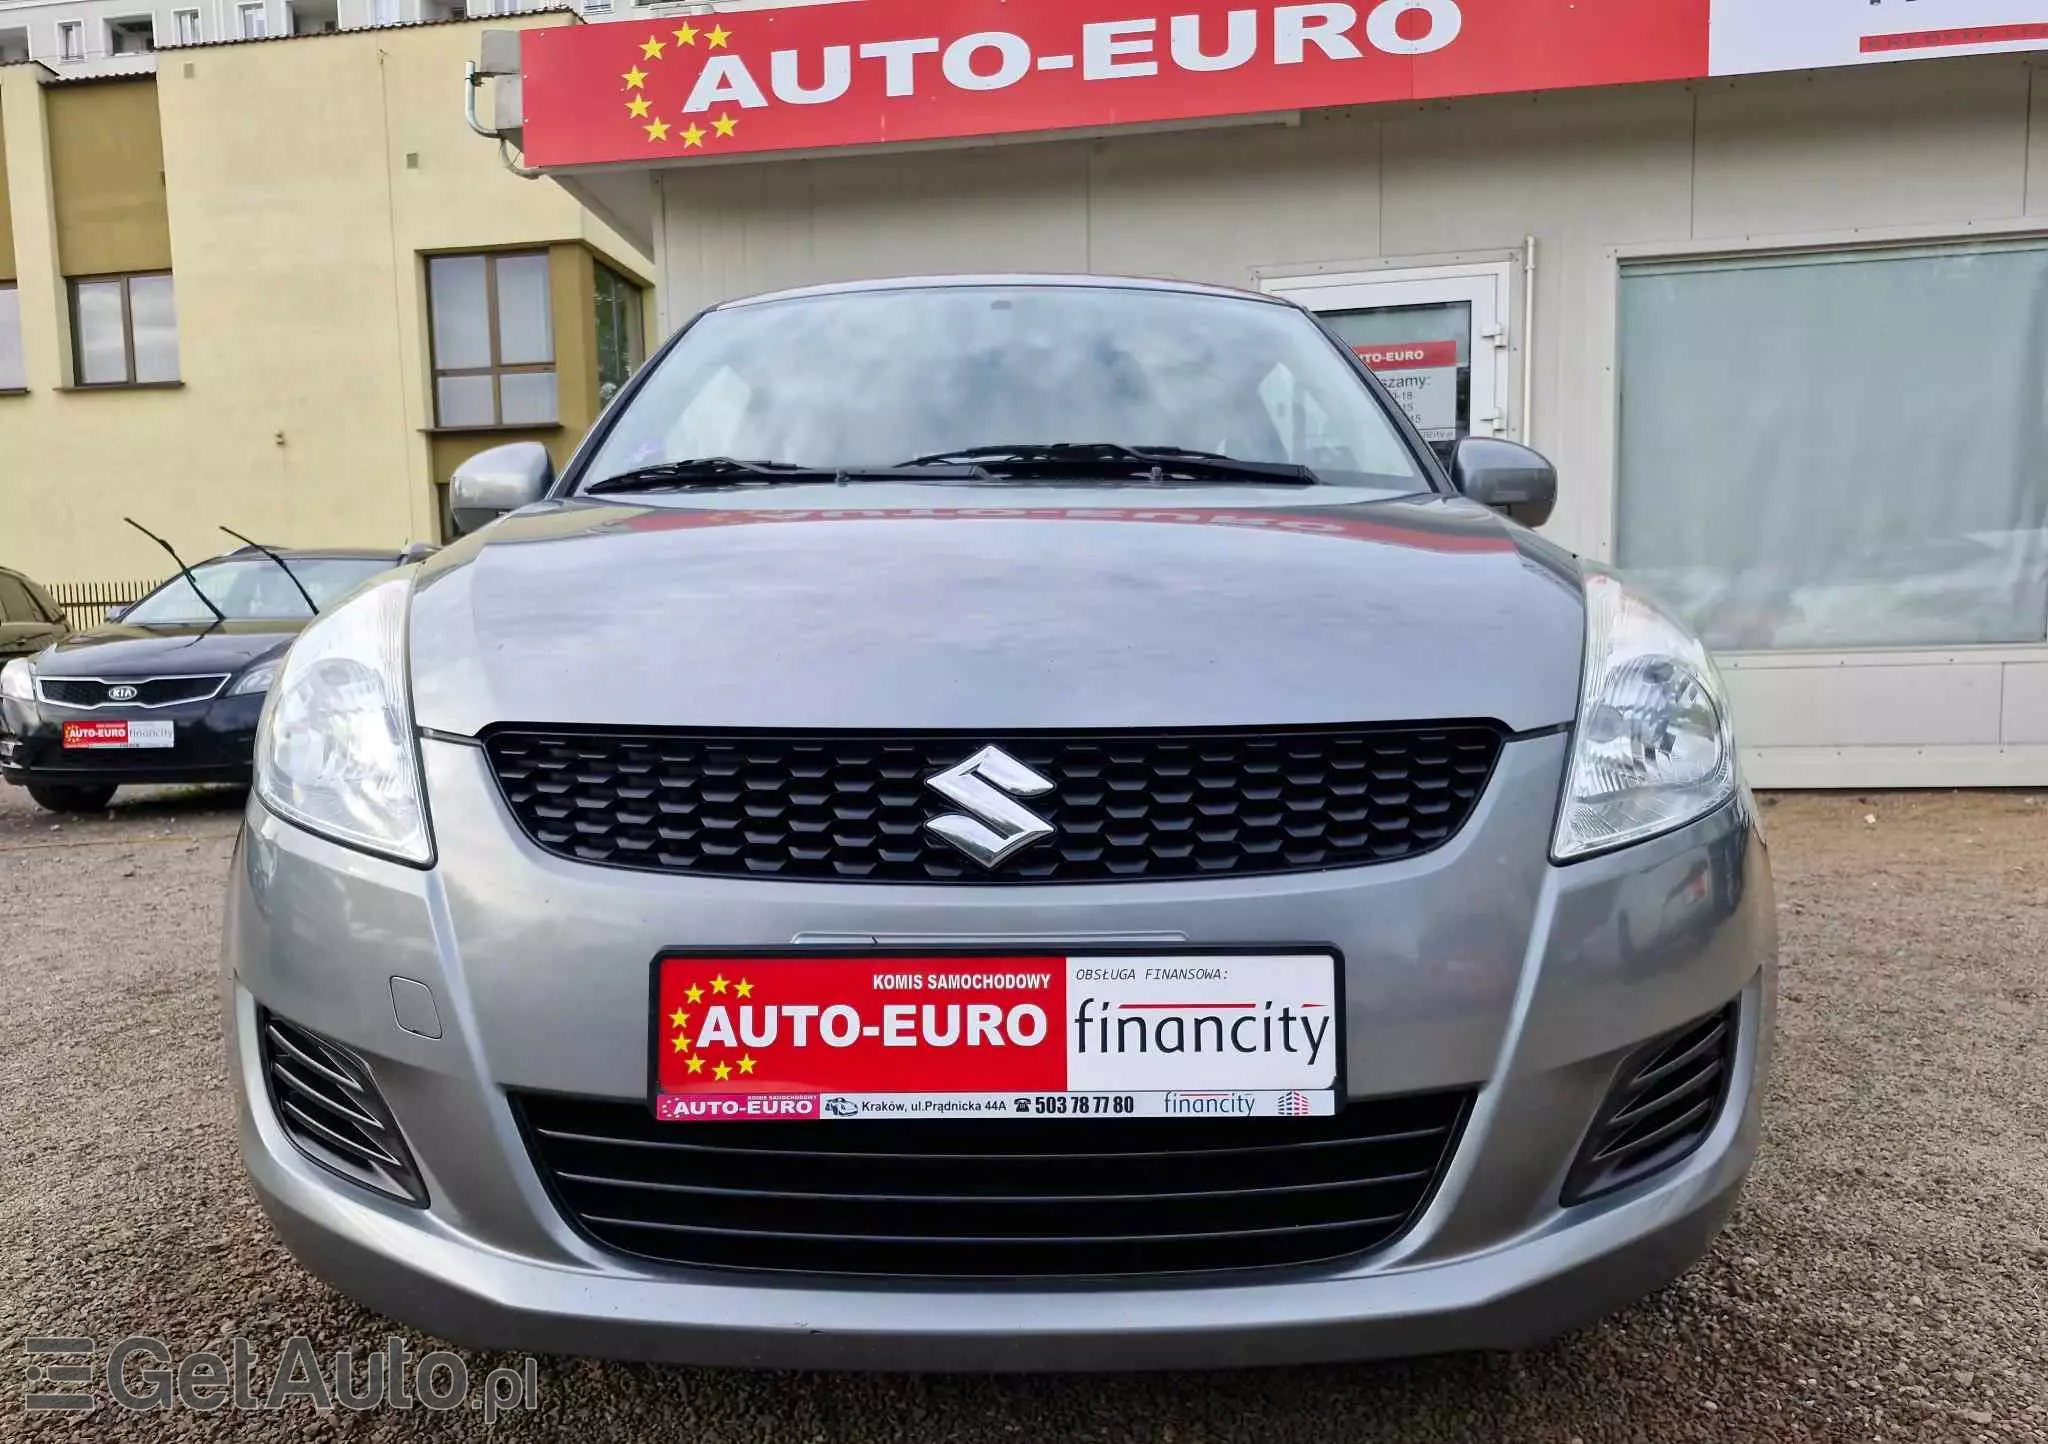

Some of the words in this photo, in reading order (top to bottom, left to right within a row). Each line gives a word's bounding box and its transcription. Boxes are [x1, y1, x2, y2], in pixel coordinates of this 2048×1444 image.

[682, 0, 1462, 113] AUTO-EURO
[1380, 375, 1431, 389] szamy:
[113, 689, 132, 697] KIA
[70, 728, 126, 737] AUTO-EURO
[873, 974, 923, 990] KOMIS
[927, 973, 1051, 990] SAMOCHODOWY
[1076, 968, 1136, 980] OBSŁUGA
[1145, 968, 1230, 980] FINANSOWA:
[696, 1002, 1047, 1048] AUTO-EURO
[1074, 998, 1330, 1065] financity
[674, 1100, 813, 1115] AUTO-EURO
[862, 1100, 907, 1113] Kraków,
[911, 1100, 981, 1114] ul.Prądnicka
[984, 1101, 1007, 1112] 44A
[1035, 1096, 1067, 1114] 503
[1070, 1096, 1089, 1114] 78
[1092, 1096, 1111, 1113] 77
[1113, 1096, 1134, 1113] 80
[1164, 1090, 1255, 1117] financity
